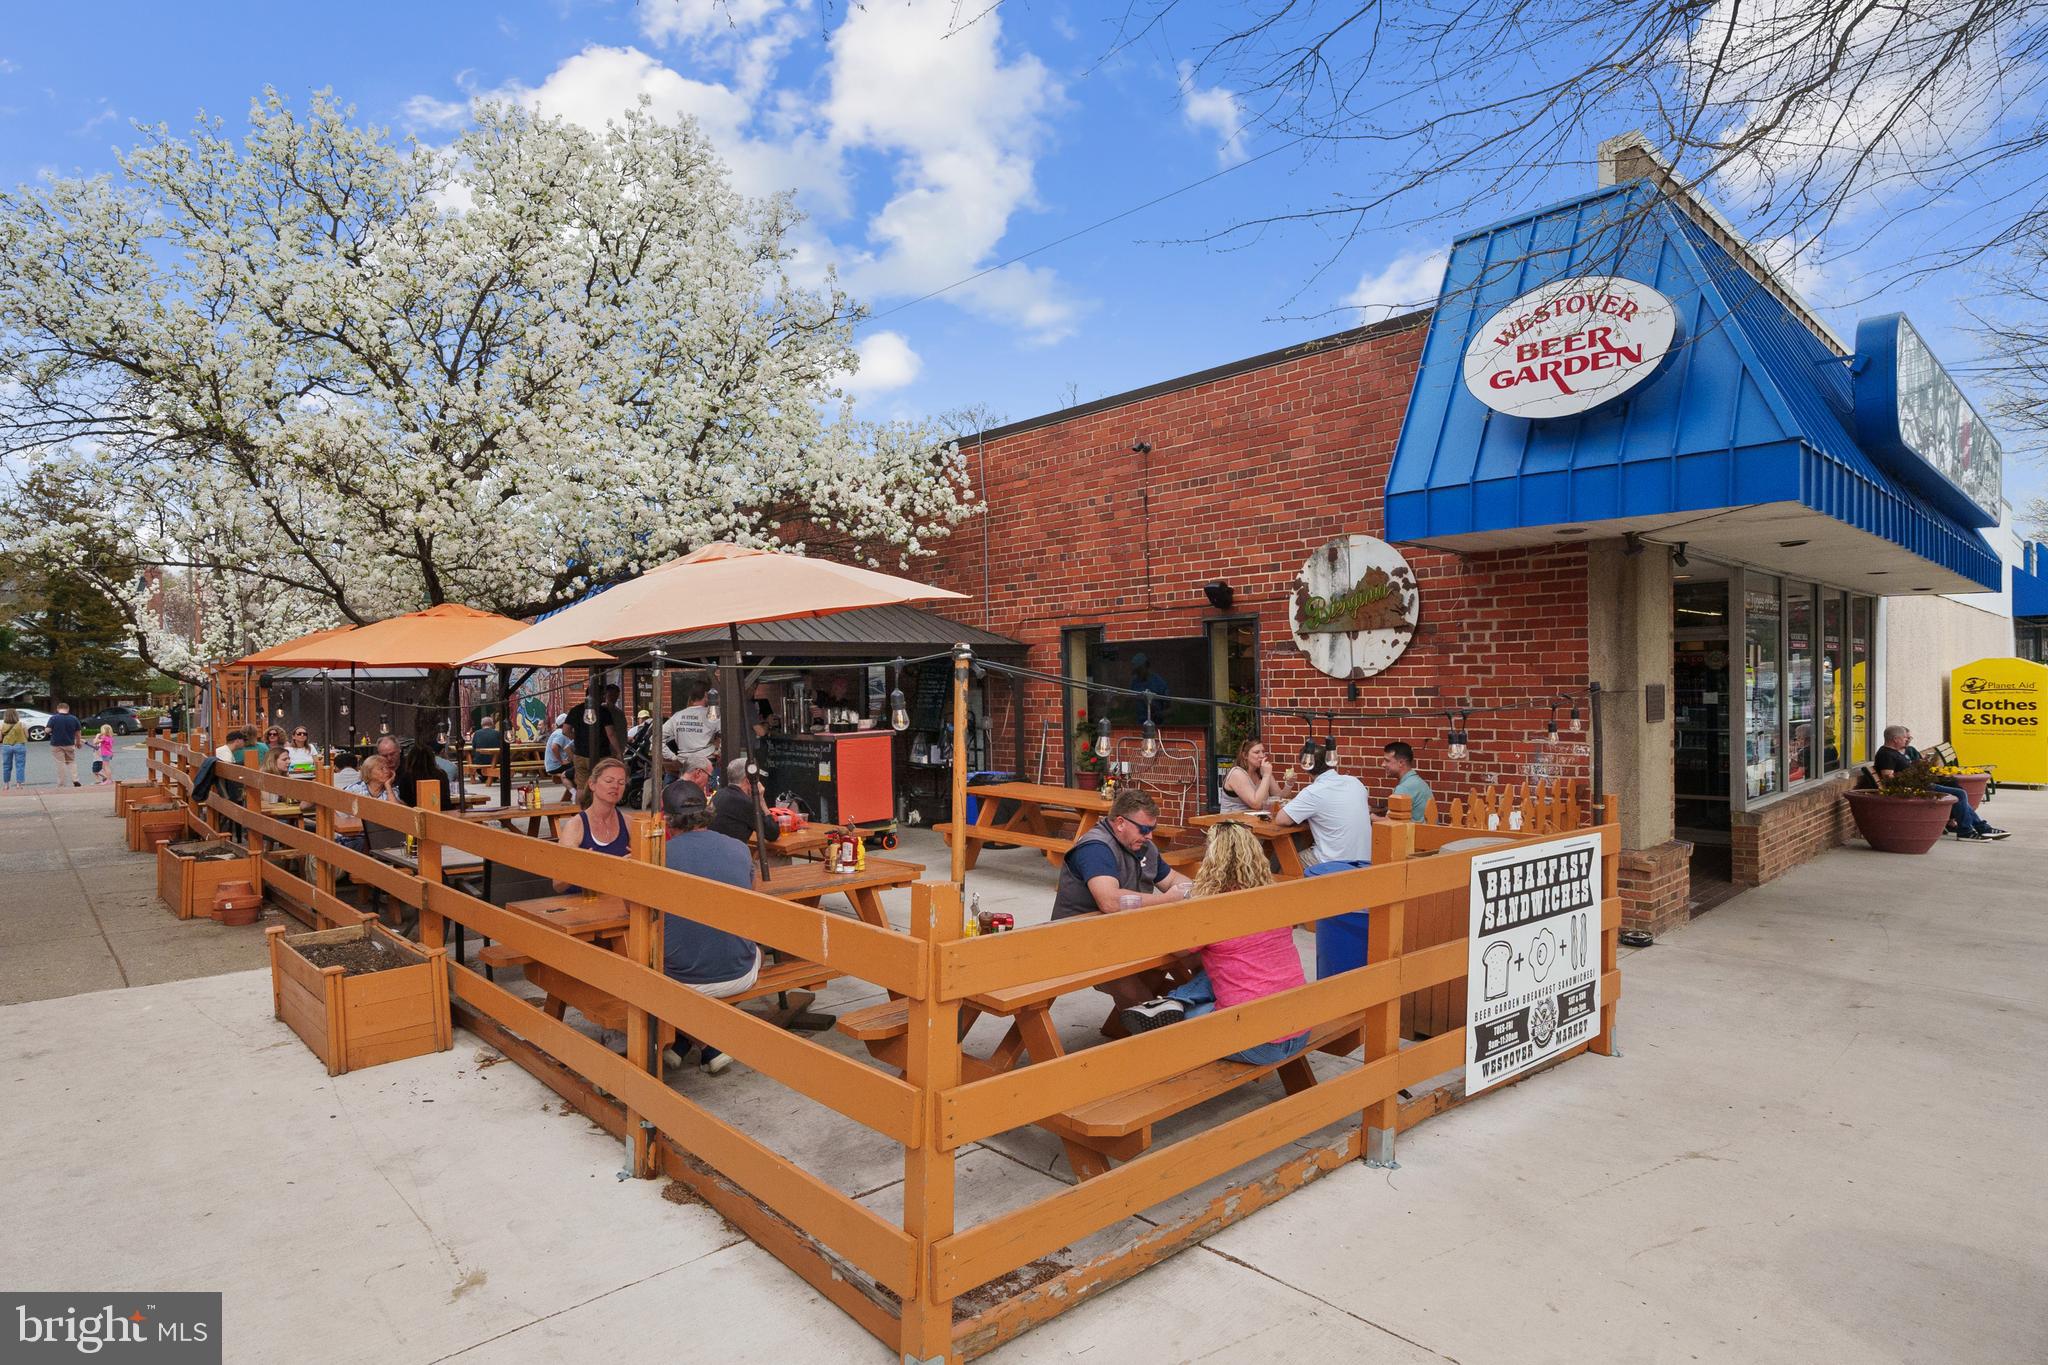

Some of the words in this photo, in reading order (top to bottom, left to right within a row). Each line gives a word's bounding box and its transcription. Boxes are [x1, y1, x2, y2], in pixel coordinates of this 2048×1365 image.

[1493, 294, 1638, 348] WESTOVER
[1516, 326, 1617, 363] BEER
[1489, 344, 1642, 395] GARDEN
[1962, 698, 2037, 711] Clothes
[1988, 681, 2015, 689] Planet
[2018, 681, 2035, 689] Aid
[1962, 713, 1976, 725] &
[1980, 713, 2038, 725] Shoes
[1486, 851, 1589, 899] BREAKFAST
[1484, 878, 1589, 930] SANDWICHES
[1474, 1007, 1492, 1022] BEER
[1494, 998, 1519, 1015] GARDEN
[1522, 983, 1556, 1005] BREAKFAST
[1558, 968, 1595, 990] SANDWICHES!
[1482, 1043, 1533, 1078] WESTOVER
[1555, 1018, 1588, 1046] MARKET
